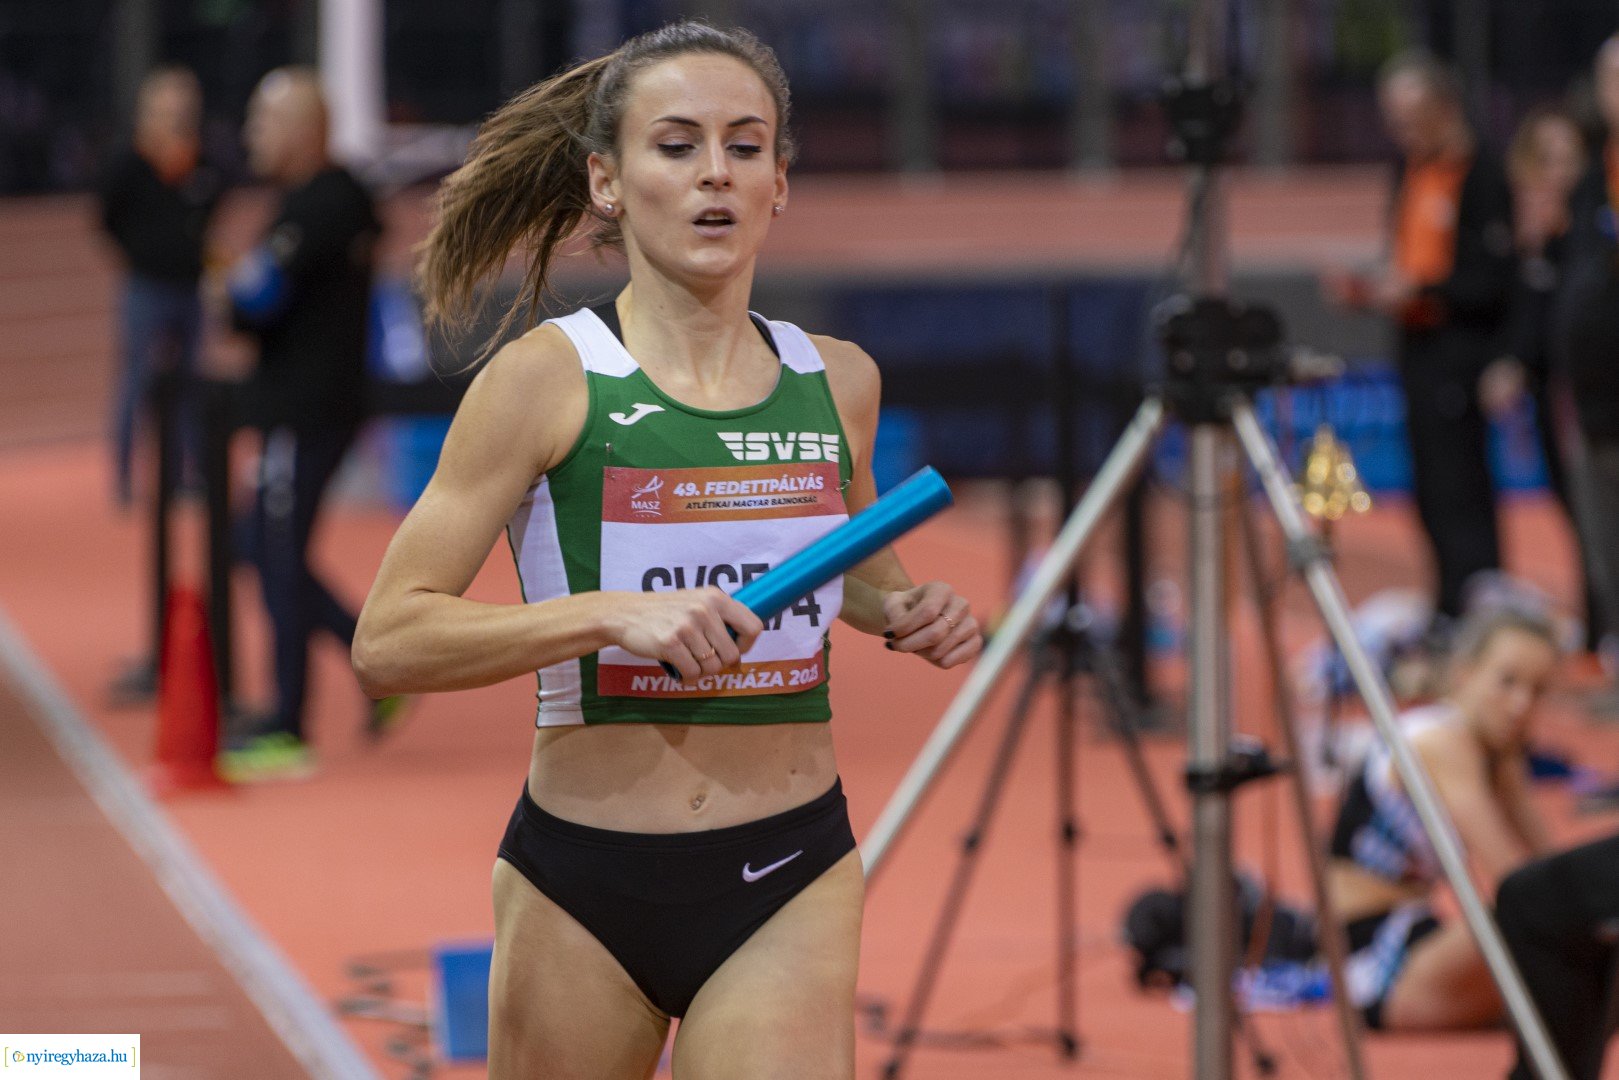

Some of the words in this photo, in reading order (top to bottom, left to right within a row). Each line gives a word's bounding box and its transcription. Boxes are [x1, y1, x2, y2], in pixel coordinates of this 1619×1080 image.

[673, 481, 700, 497] 49.
[704, 473, 825, 496] FEDETTPÁLYÁS
[631, 500, 661, 510] MASZ
[685, 499, 730, 510] ATLÉTIKAI
[732, 498, 769, 508] MAGYAR
